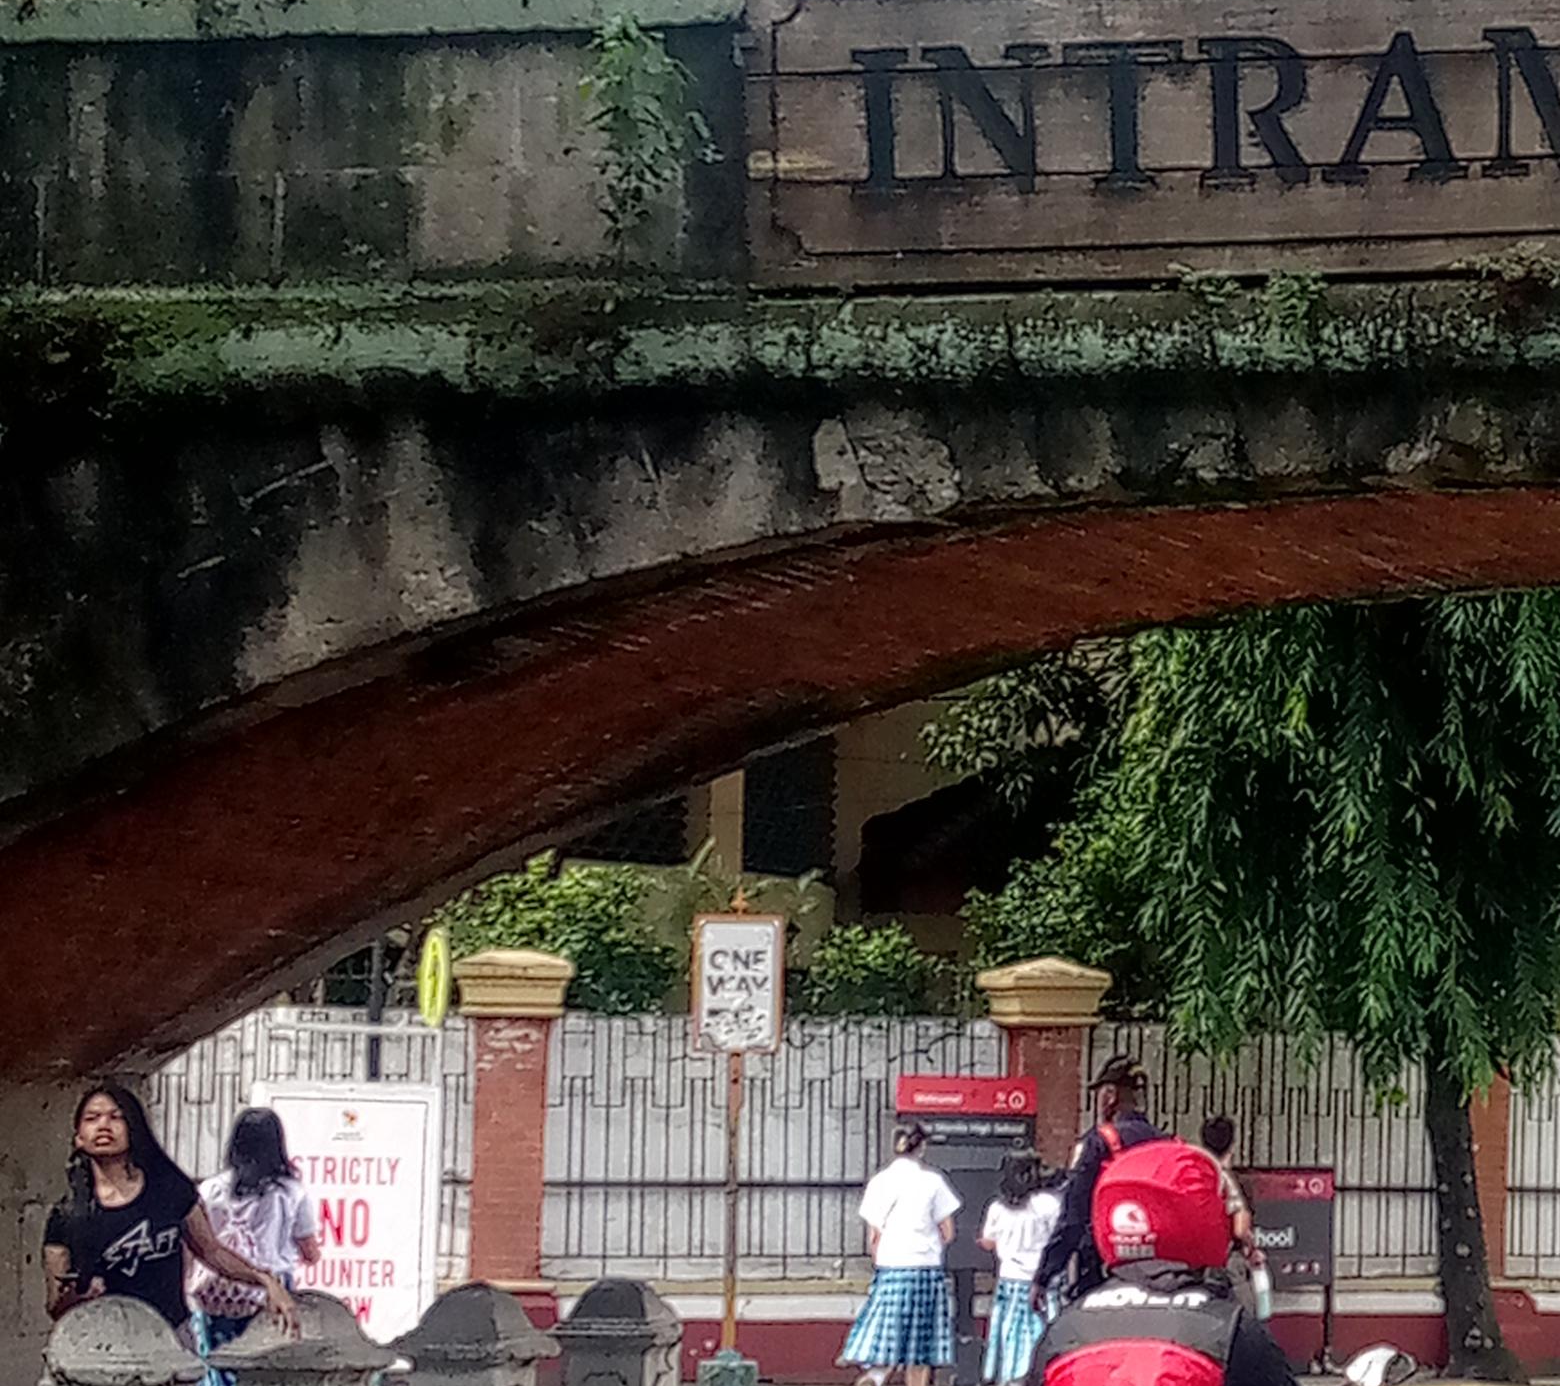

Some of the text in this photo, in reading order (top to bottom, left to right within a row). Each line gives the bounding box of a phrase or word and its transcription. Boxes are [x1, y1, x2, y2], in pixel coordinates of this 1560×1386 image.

[708, 948, 768, 973] ONE
[289, 1155, 400, 1185] STRICTLY
[318, 1198, 370, 1248] NO
[294, 1258, 395, 1288] OUNTER
